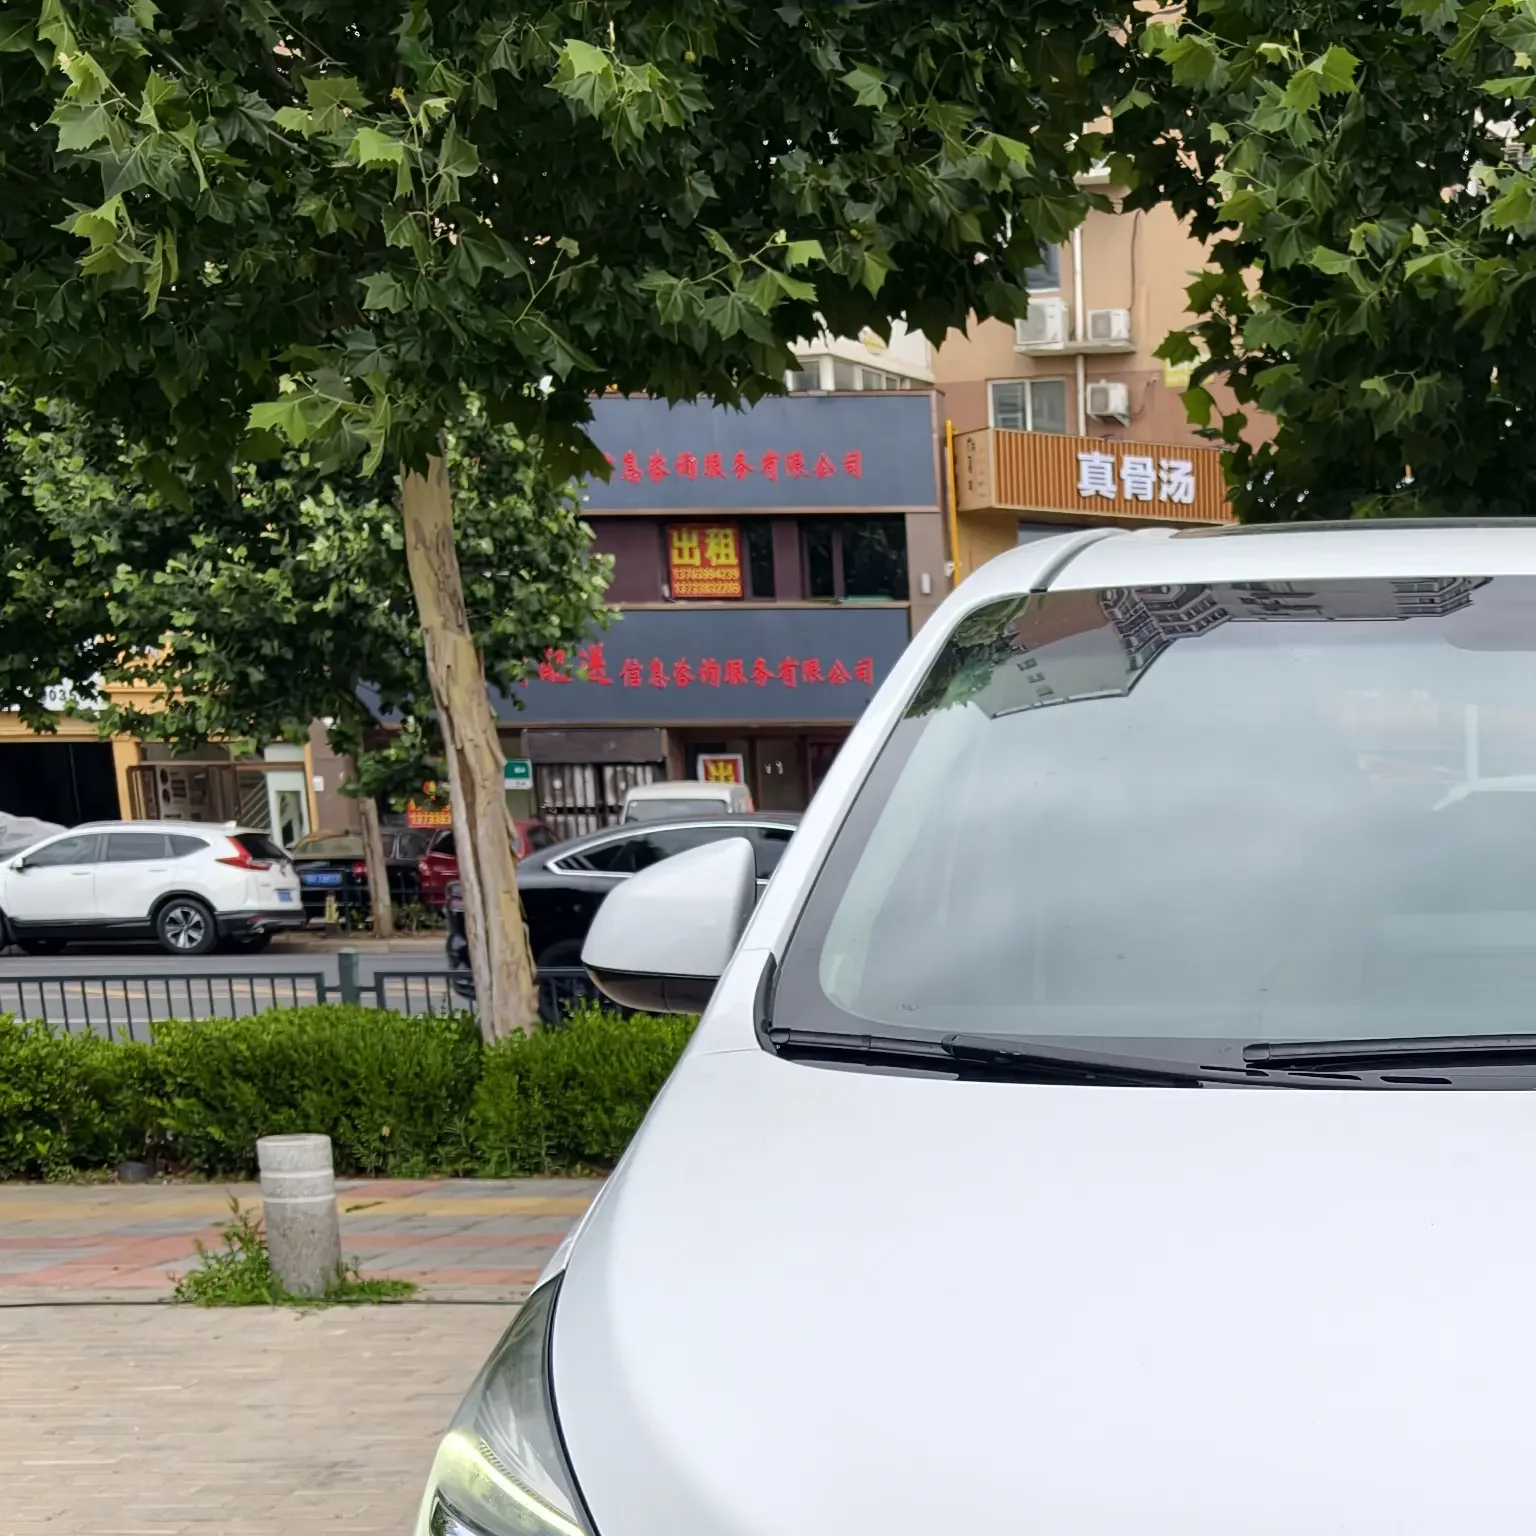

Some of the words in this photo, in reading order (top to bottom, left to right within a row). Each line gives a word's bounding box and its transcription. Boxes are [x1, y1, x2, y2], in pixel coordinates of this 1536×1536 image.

[604, 448, 862, 485] 息咨询服务有限公司
[1076, 451, 1196, 504] 真骨汤
[671, 528, 739, 567] 出租
[620, 655, 875, 688] 信息咨询服务有限公司
